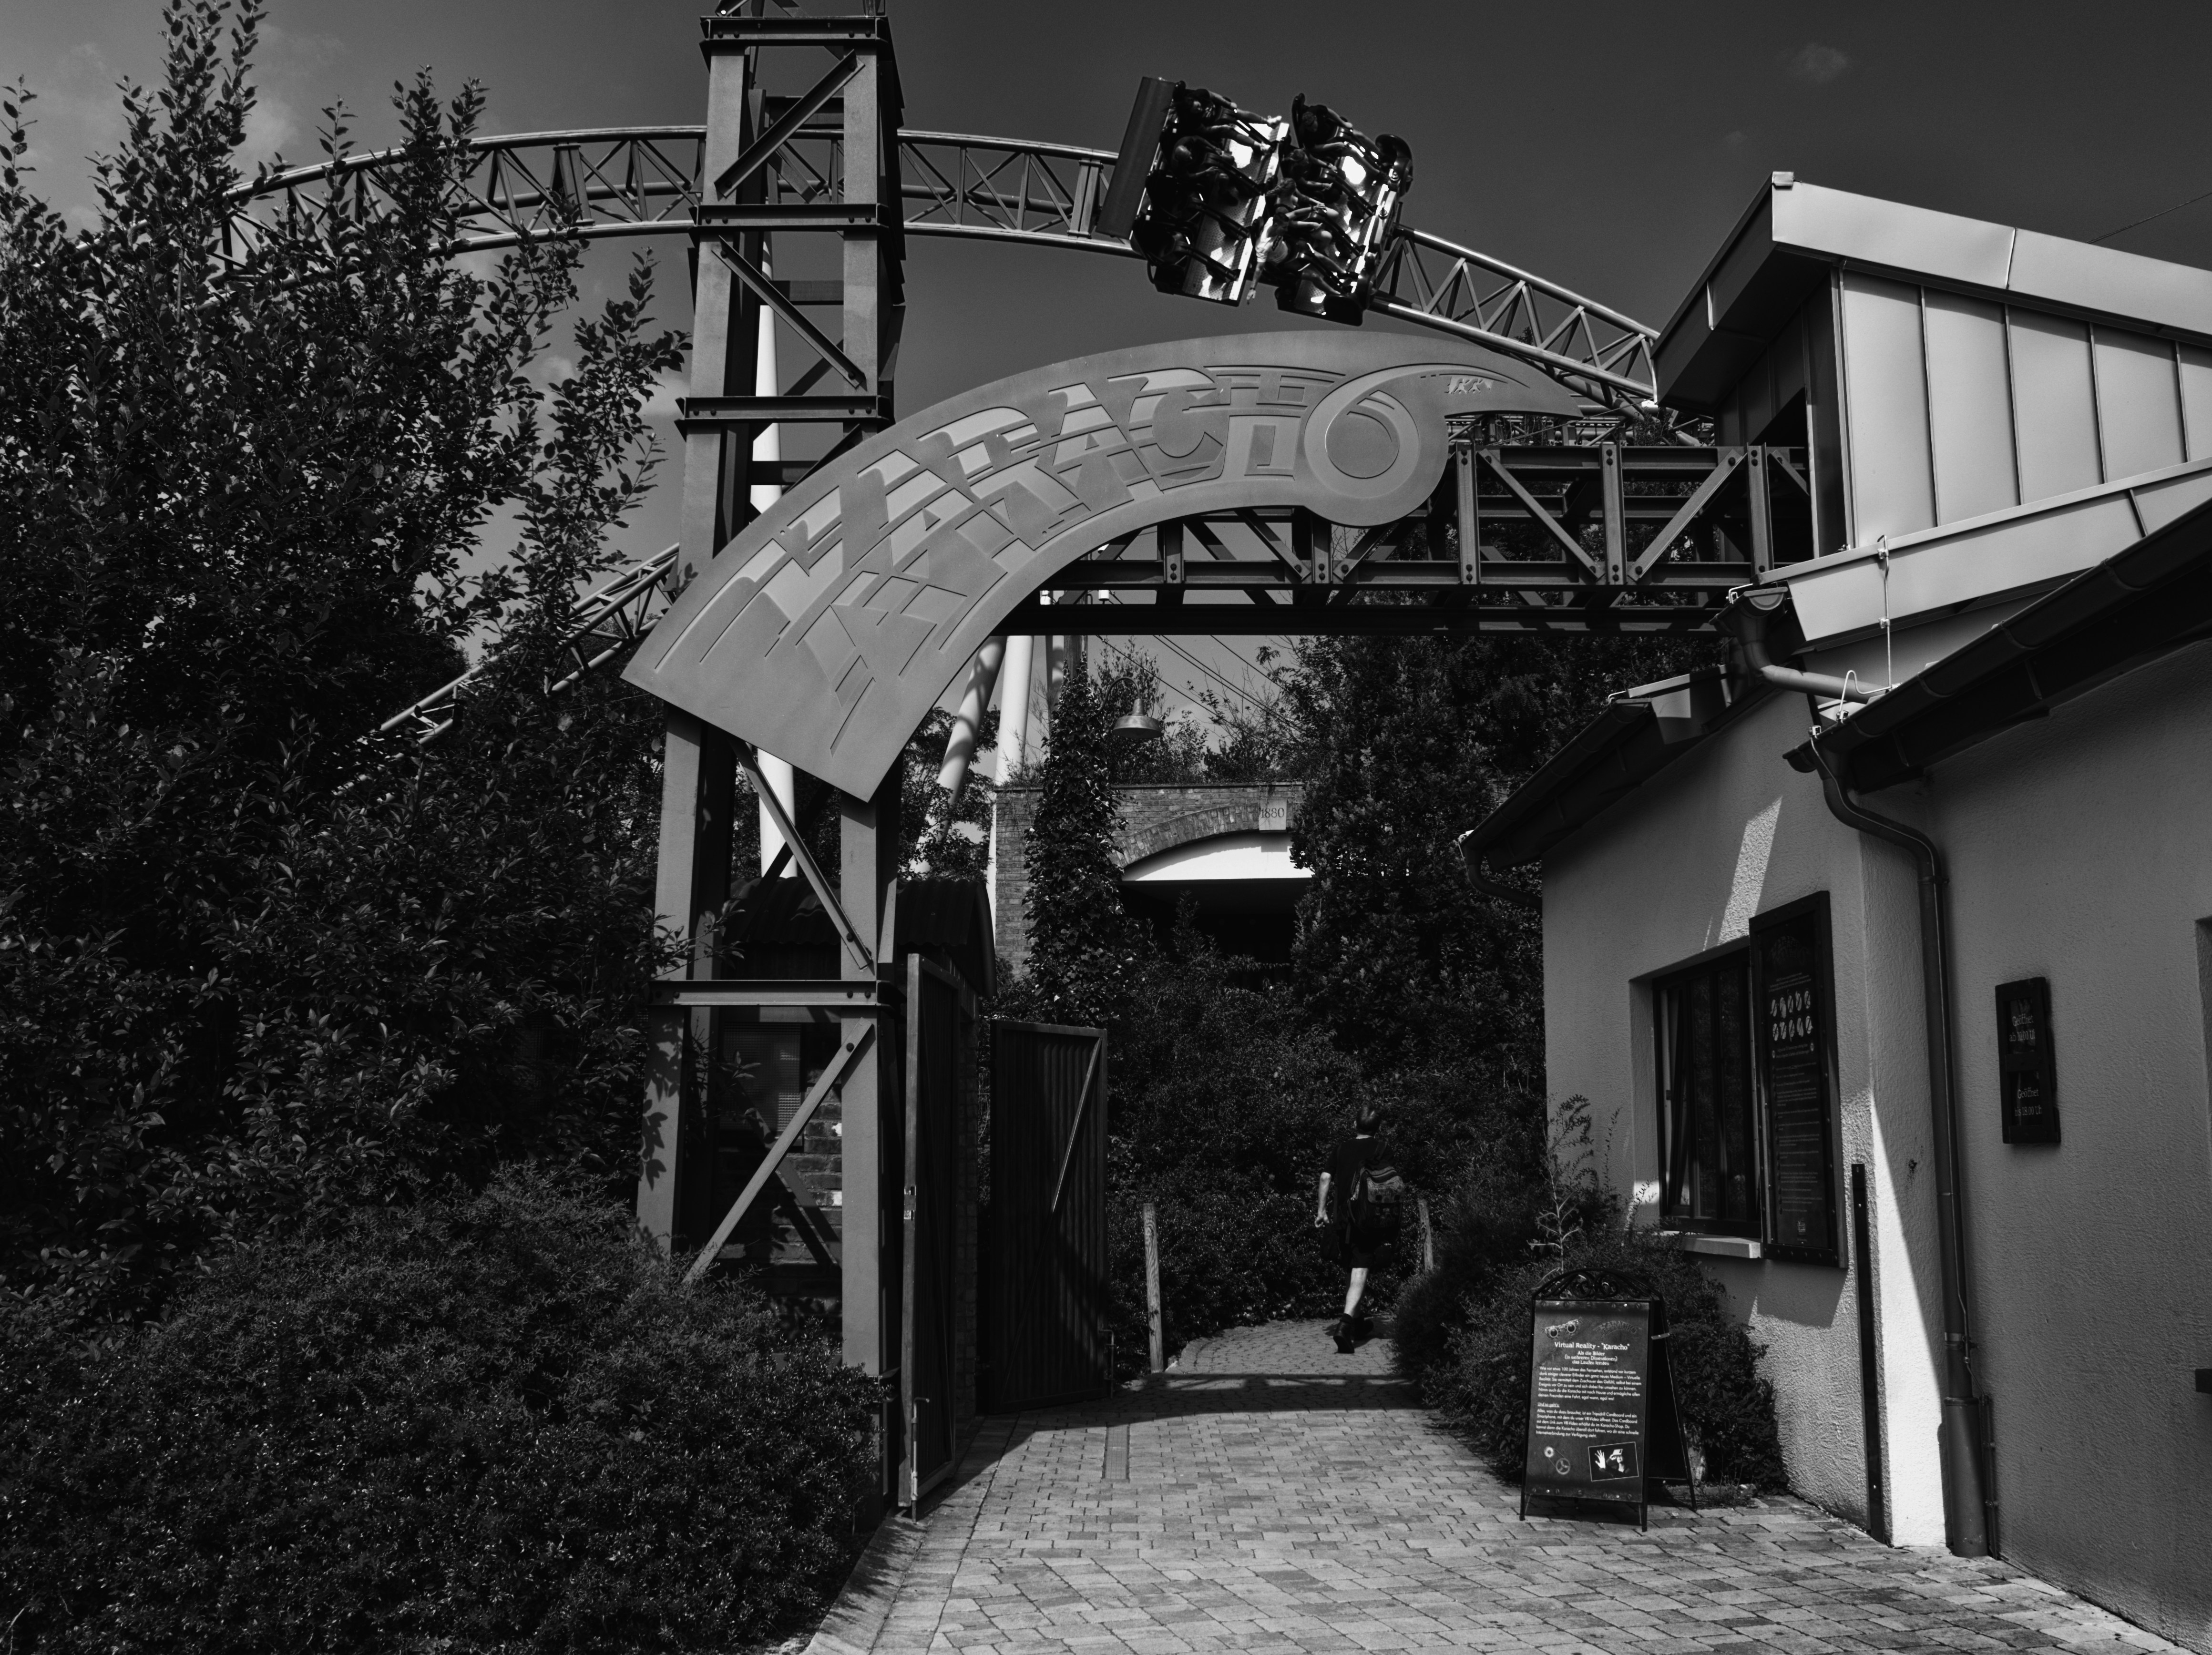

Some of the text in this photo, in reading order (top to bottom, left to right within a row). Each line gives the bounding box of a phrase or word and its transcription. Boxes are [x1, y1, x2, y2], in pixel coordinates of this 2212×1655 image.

[1261, 807, 1285, 818] 1880
[2012, 1013, 2034, 1026] Geöffnet
[2017, 1087, 2039, 1099] Geöffnet
